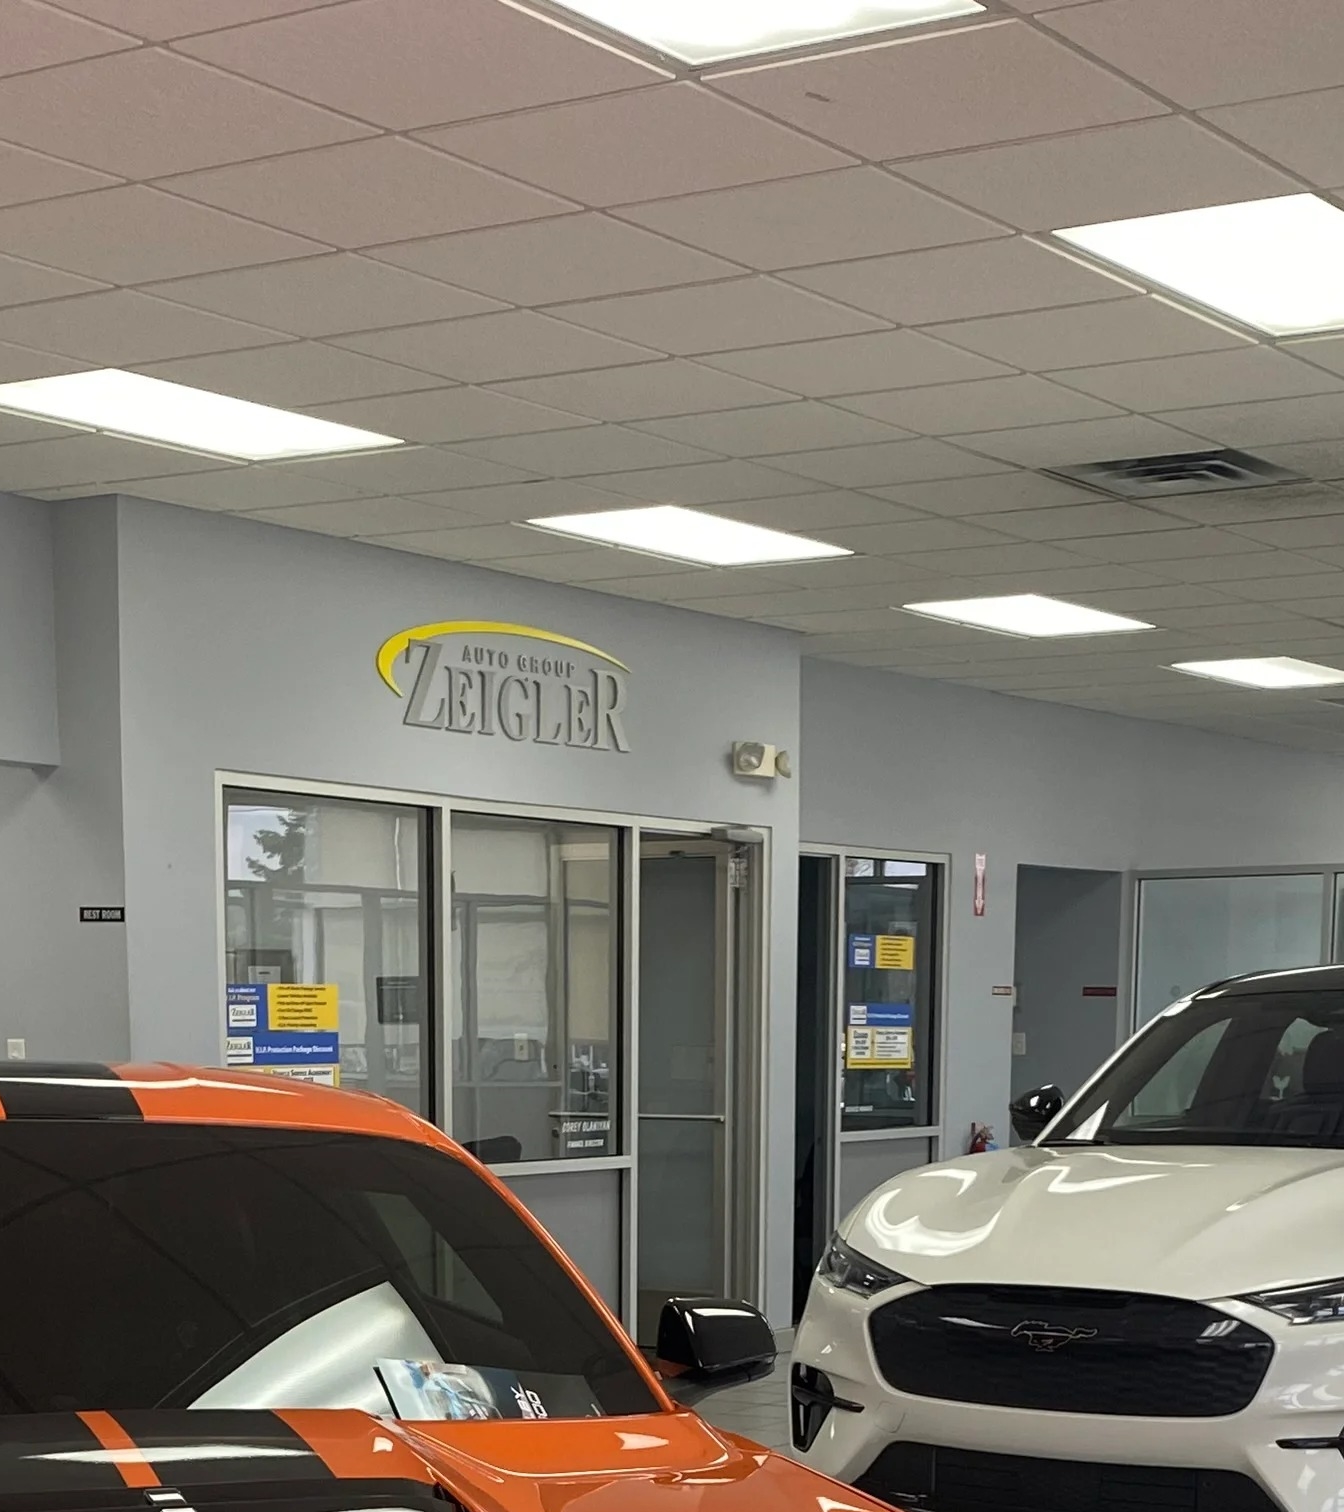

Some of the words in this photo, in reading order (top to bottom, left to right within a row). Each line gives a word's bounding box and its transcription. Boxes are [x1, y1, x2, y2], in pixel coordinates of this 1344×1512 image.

[461, 645, 509, 669] AUTO
[516, 655, 578, 678] GROUP
[403, 638, 631, 753] ZEIGLER
[83, 909, 100, 920] REST
[101, 909, 122, 920] ROOM
